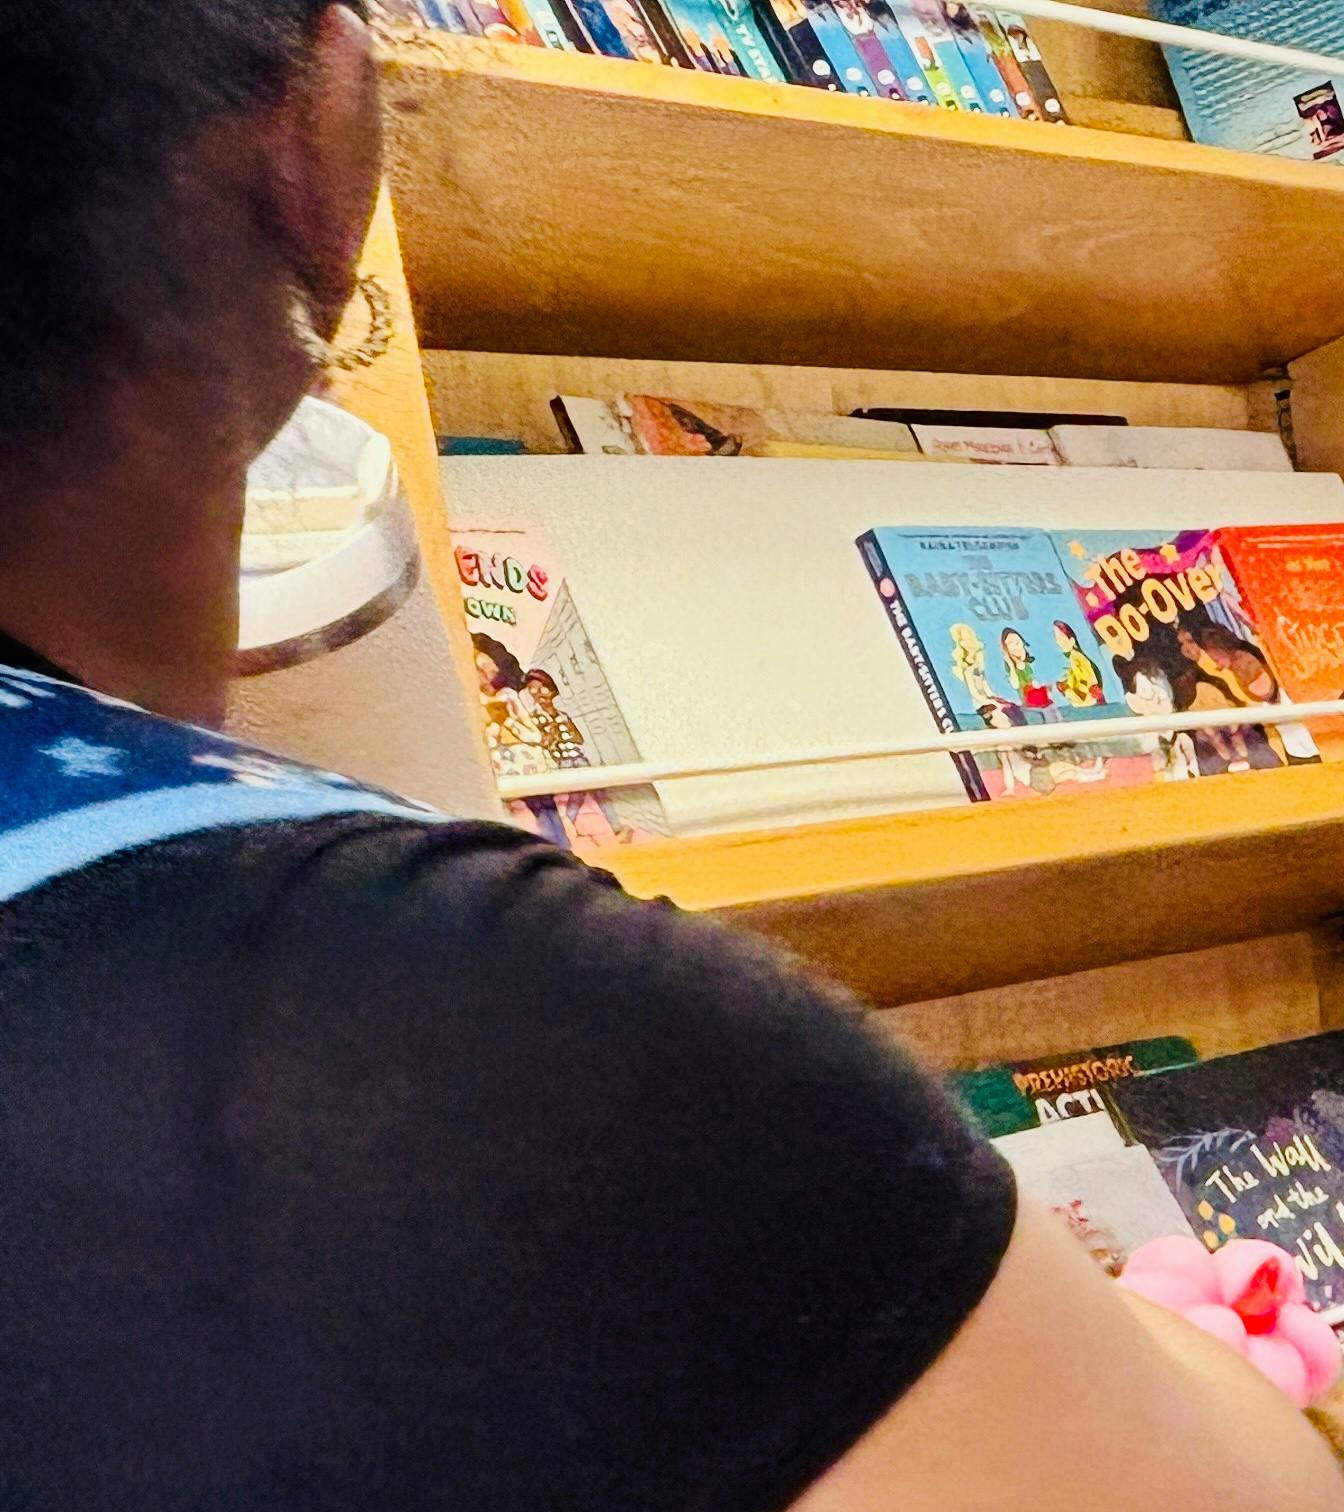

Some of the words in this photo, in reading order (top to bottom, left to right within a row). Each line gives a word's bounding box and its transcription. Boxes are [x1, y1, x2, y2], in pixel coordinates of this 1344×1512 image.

[1084, 547, 1148, 602] The
[1093, 560, 1224, 662] Do-Over
[1205, 1165, 1260, 1204] The
[1250, 1134, 1332, 1178] Wall
[1257, 1193, 1297, 1230] and
[1286, 1181, 1330, 1209] the
